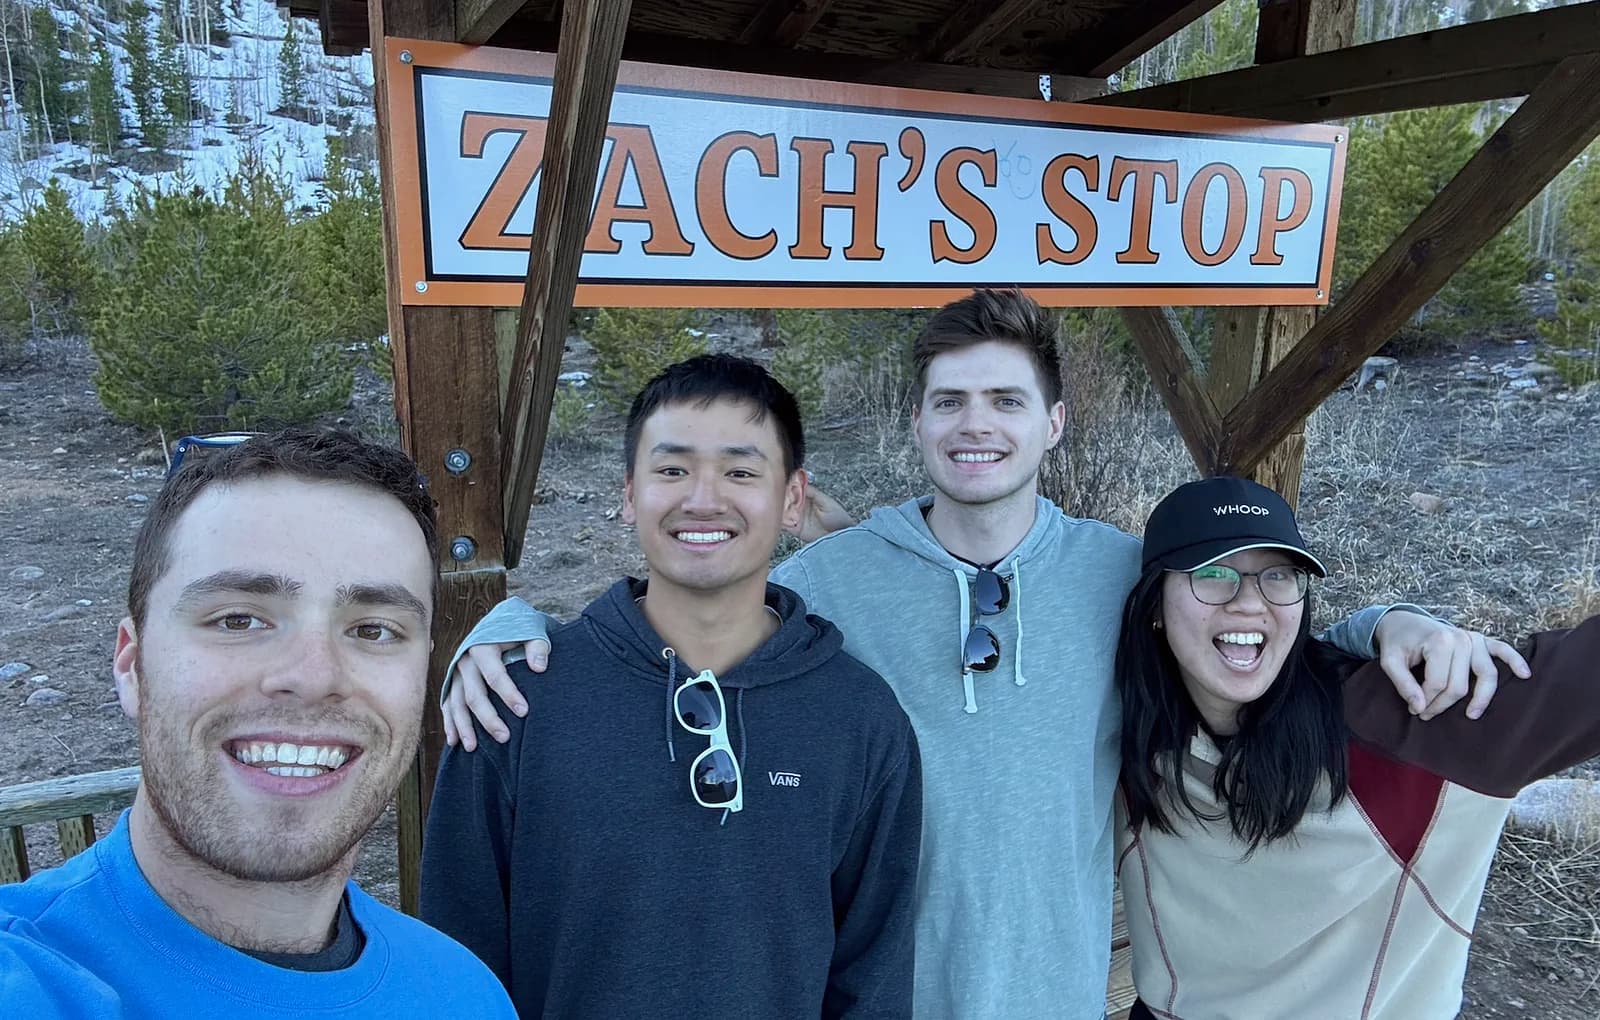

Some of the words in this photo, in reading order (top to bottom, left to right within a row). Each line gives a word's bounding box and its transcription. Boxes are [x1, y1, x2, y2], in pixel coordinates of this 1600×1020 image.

[458, 110, 998, 266] ZACH'S
[1036, 152, 1314, 267] STOP
[1212, 504, 1270, 516] WHOOP
[768, 771, 802, 787] VANS
